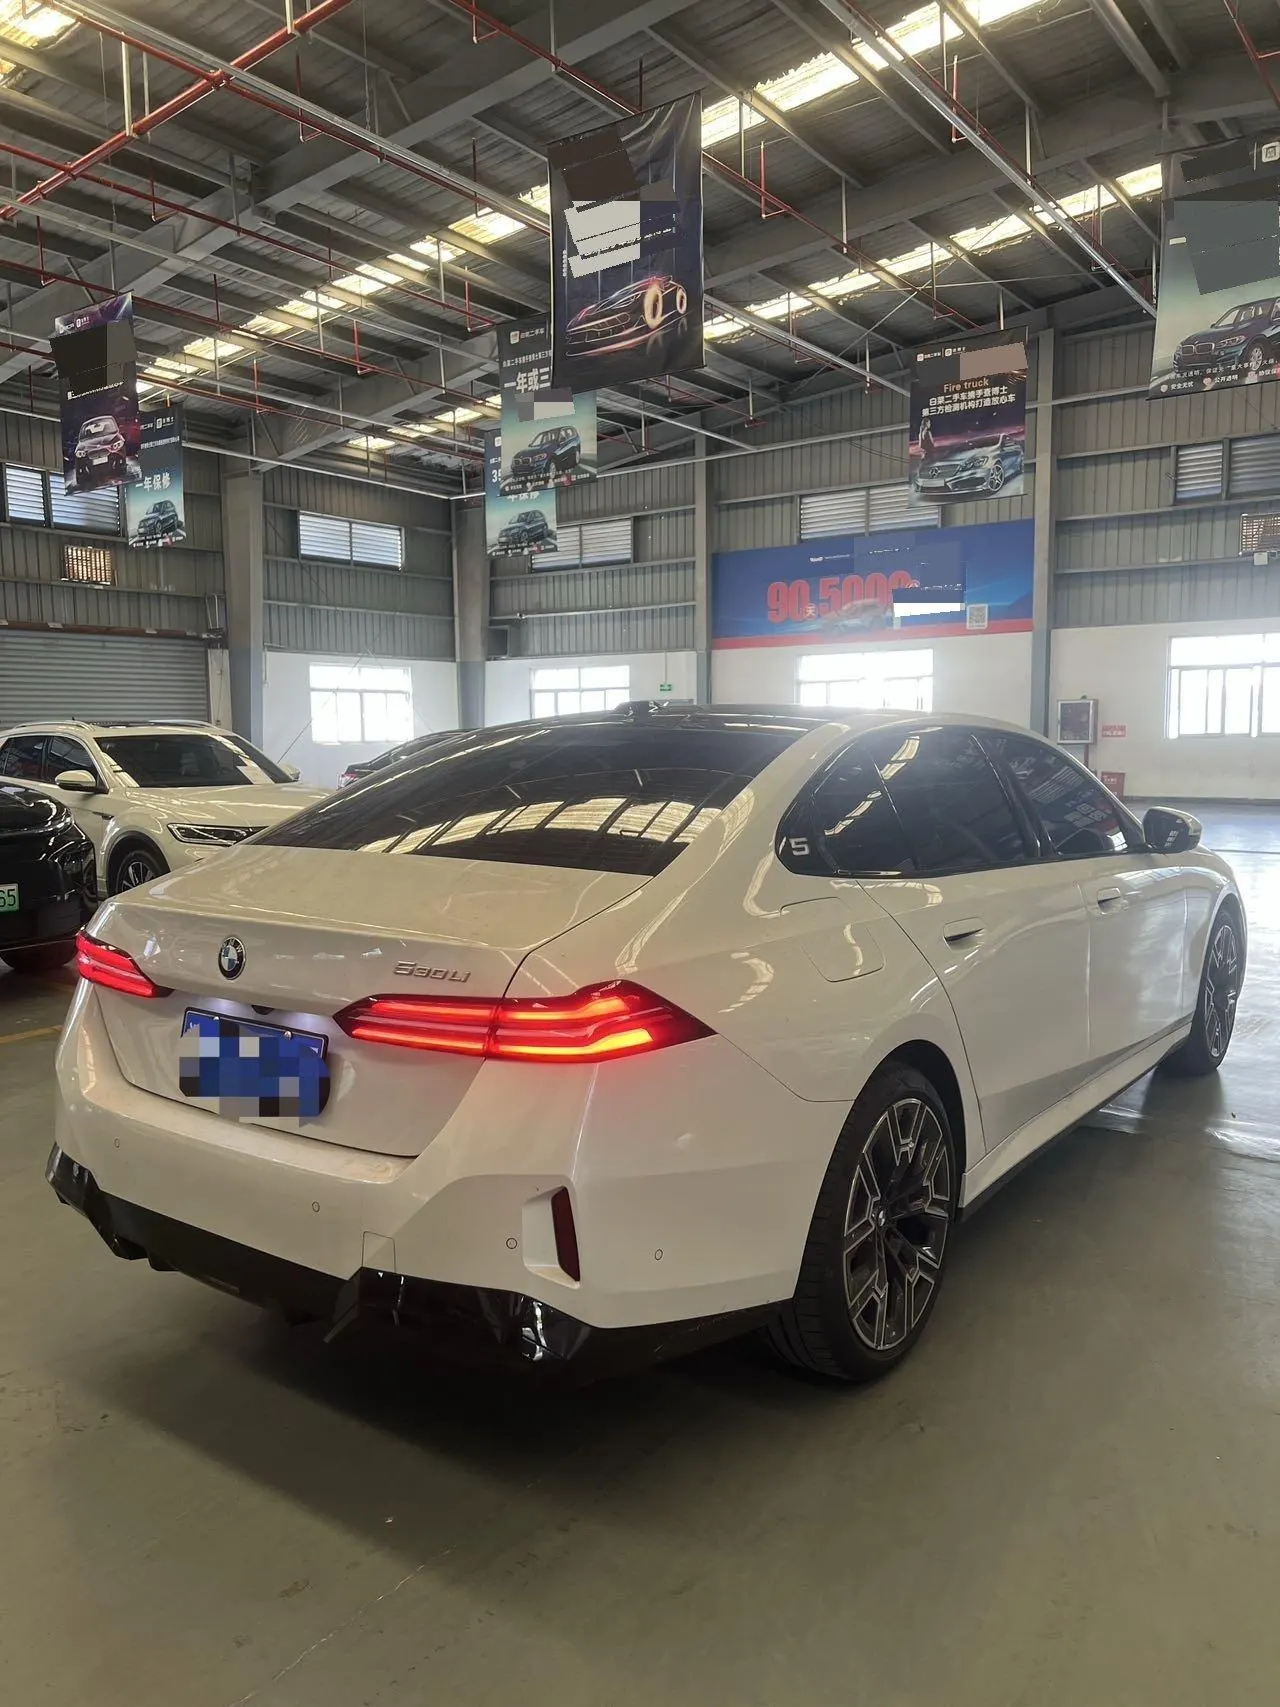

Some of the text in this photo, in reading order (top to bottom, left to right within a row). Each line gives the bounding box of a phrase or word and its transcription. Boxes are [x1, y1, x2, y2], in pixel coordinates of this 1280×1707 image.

[943, 377, 989, 393] Fire truck
[788, 837, 810, 856] 5
